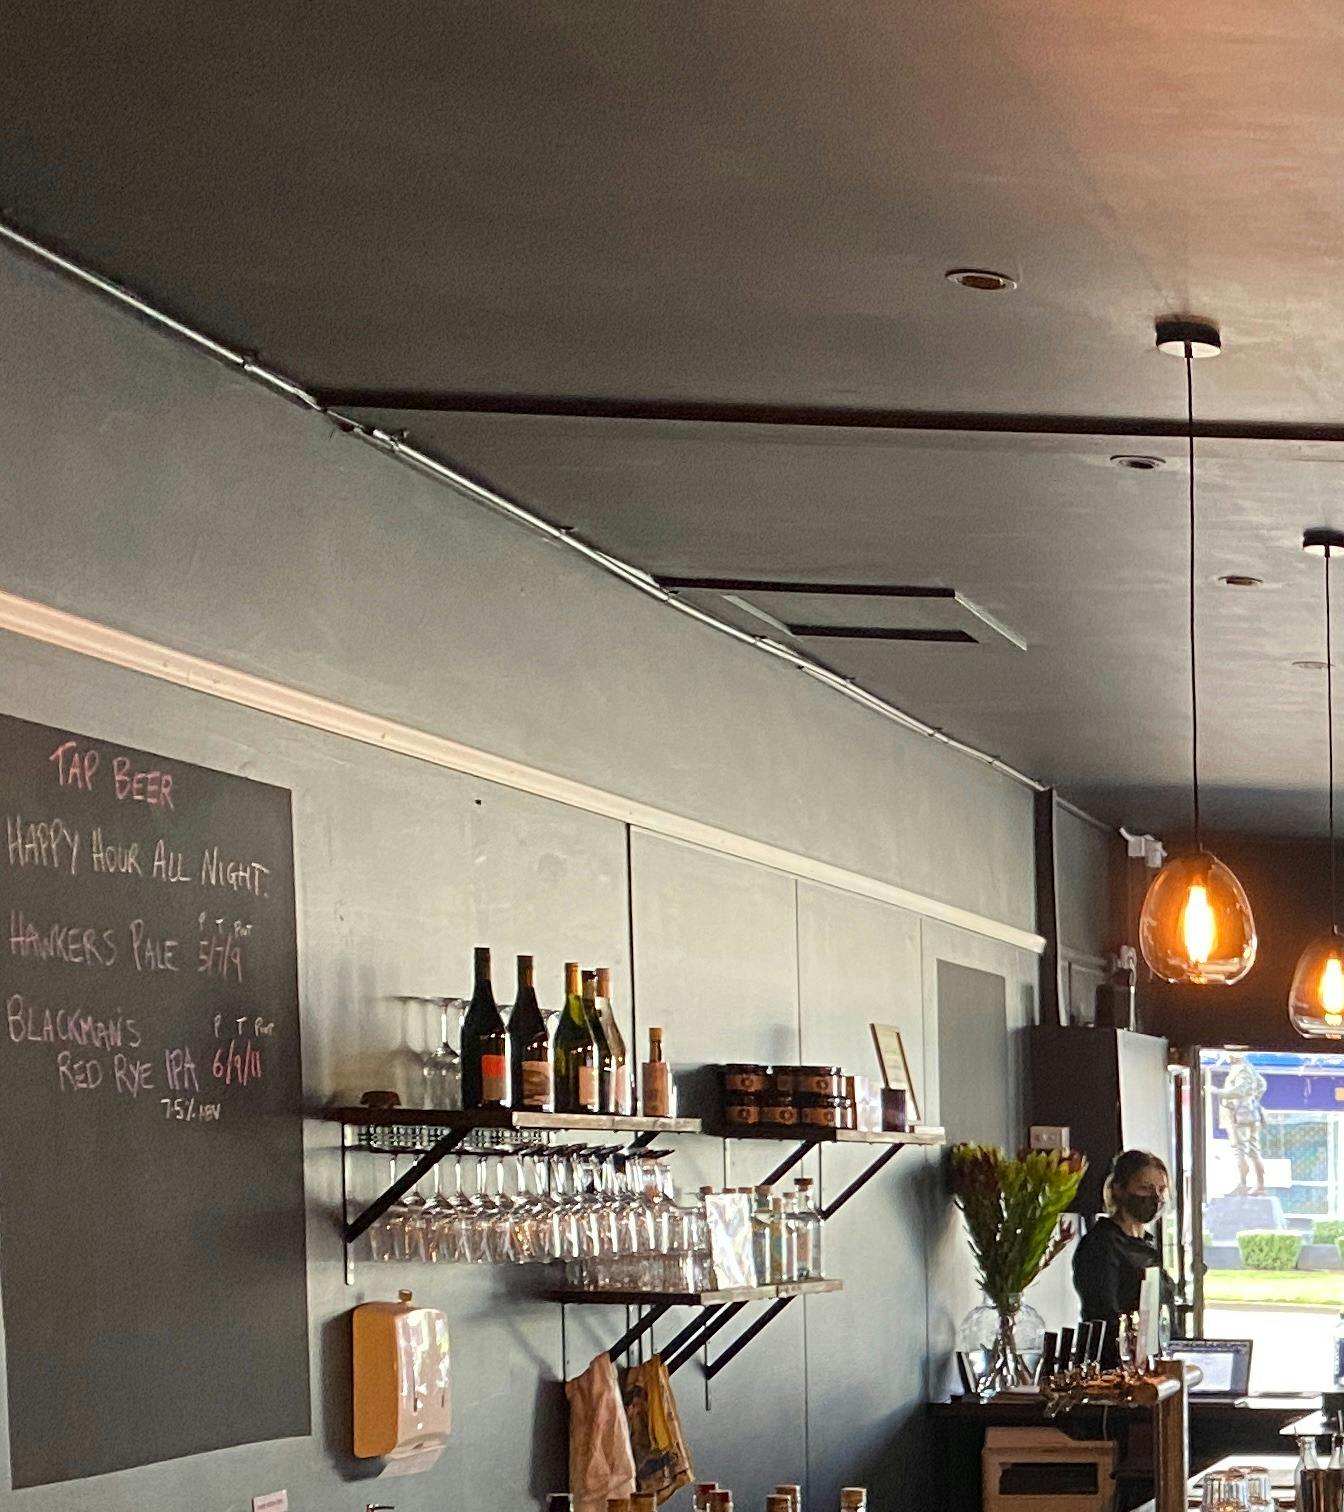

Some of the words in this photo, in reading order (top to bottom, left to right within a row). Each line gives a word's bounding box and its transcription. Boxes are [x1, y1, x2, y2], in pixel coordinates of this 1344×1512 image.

[50, 740, 98, 791] TAP
[112, 756, 174, 809] BEER
[6, 815, 80, 875] HAPPY
[92, 828, 140, 875] HOUR
[153, 839, 191, 882] ALL
[9, 910, 117, 966] HAWKERS
[129, 919, 179, 972] PALE
[57, 1050, 102, 1092] RED
[114, 1053, 154, 1098] RYE
[165, 1046, 199, 1092] IPA
